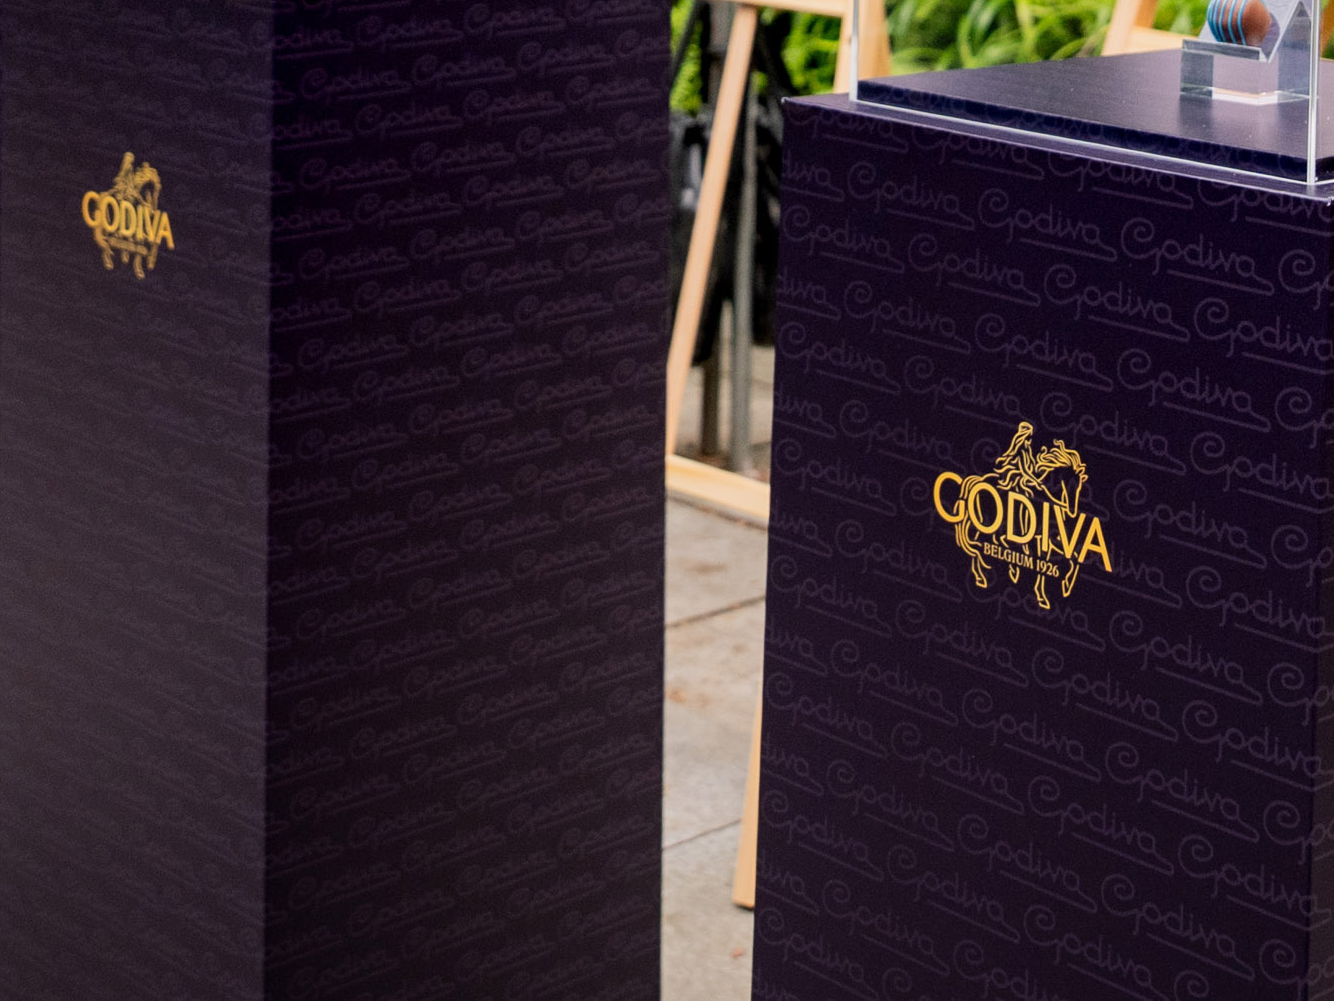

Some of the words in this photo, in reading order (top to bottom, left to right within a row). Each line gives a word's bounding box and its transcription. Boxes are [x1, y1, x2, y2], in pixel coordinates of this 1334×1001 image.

[81, 190, 175, 250] GODIVA
[933, 471, 1113, 573] GODIVA
[983, 542, 1034, 570] BELGIUM
[1036, 559, 1060, 578] 1926
